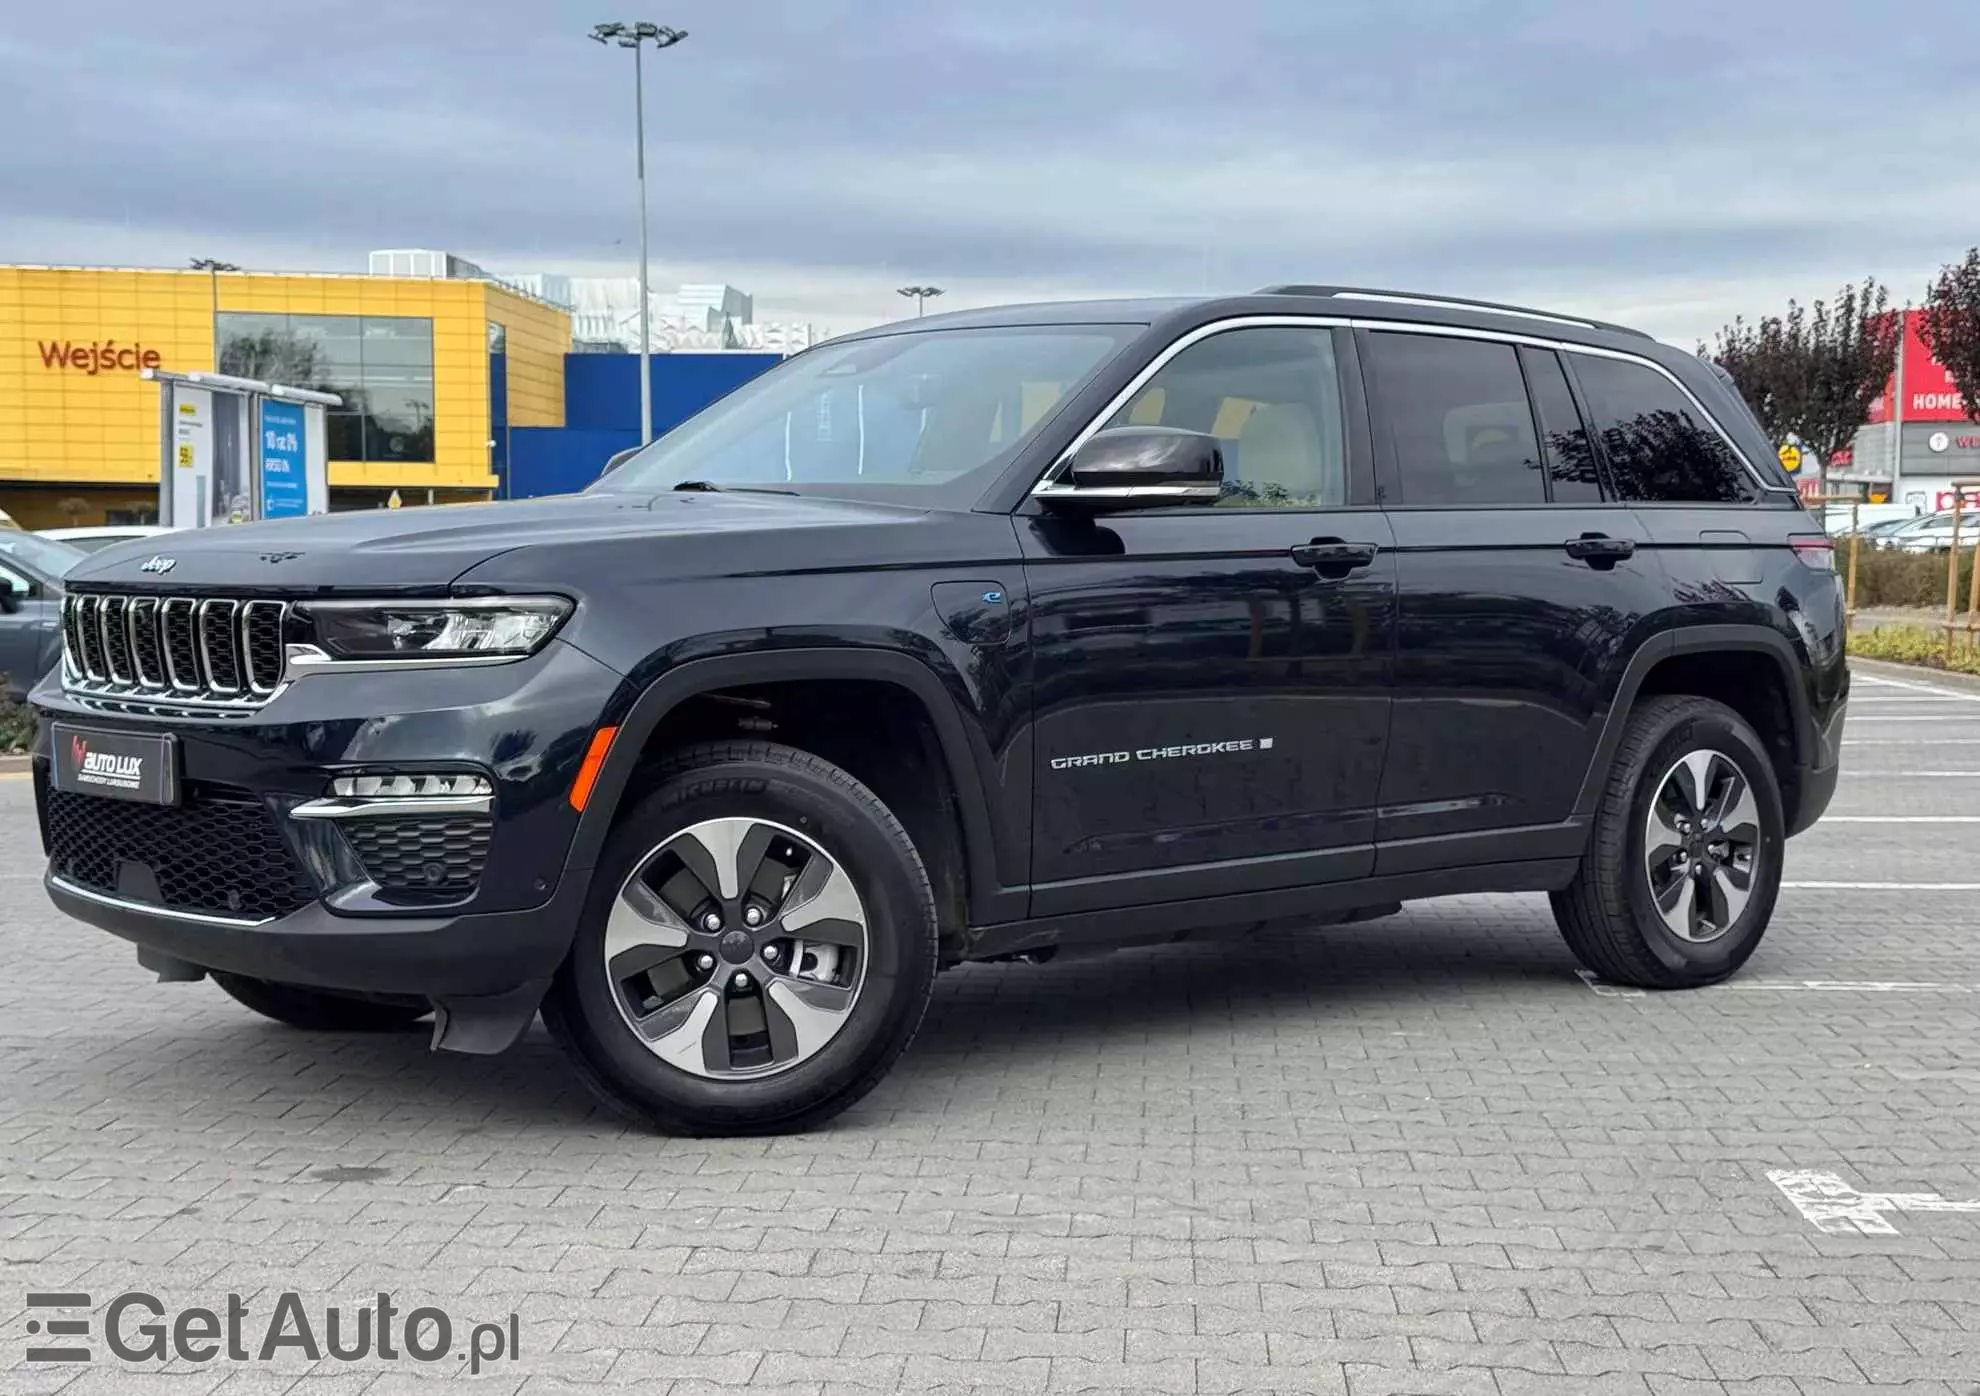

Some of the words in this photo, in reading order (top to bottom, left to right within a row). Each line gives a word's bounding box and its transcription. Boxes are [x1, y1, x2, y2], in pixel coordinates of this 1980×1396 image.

[38, 339, 161, 375] Wejście
[141, 555, 176, 574] Jeep
[116, 756, 143, 776] LUX
[1050, 751, 1130, 769] GRAND
[1136, 739, 1253, 760] CHEROKEE
